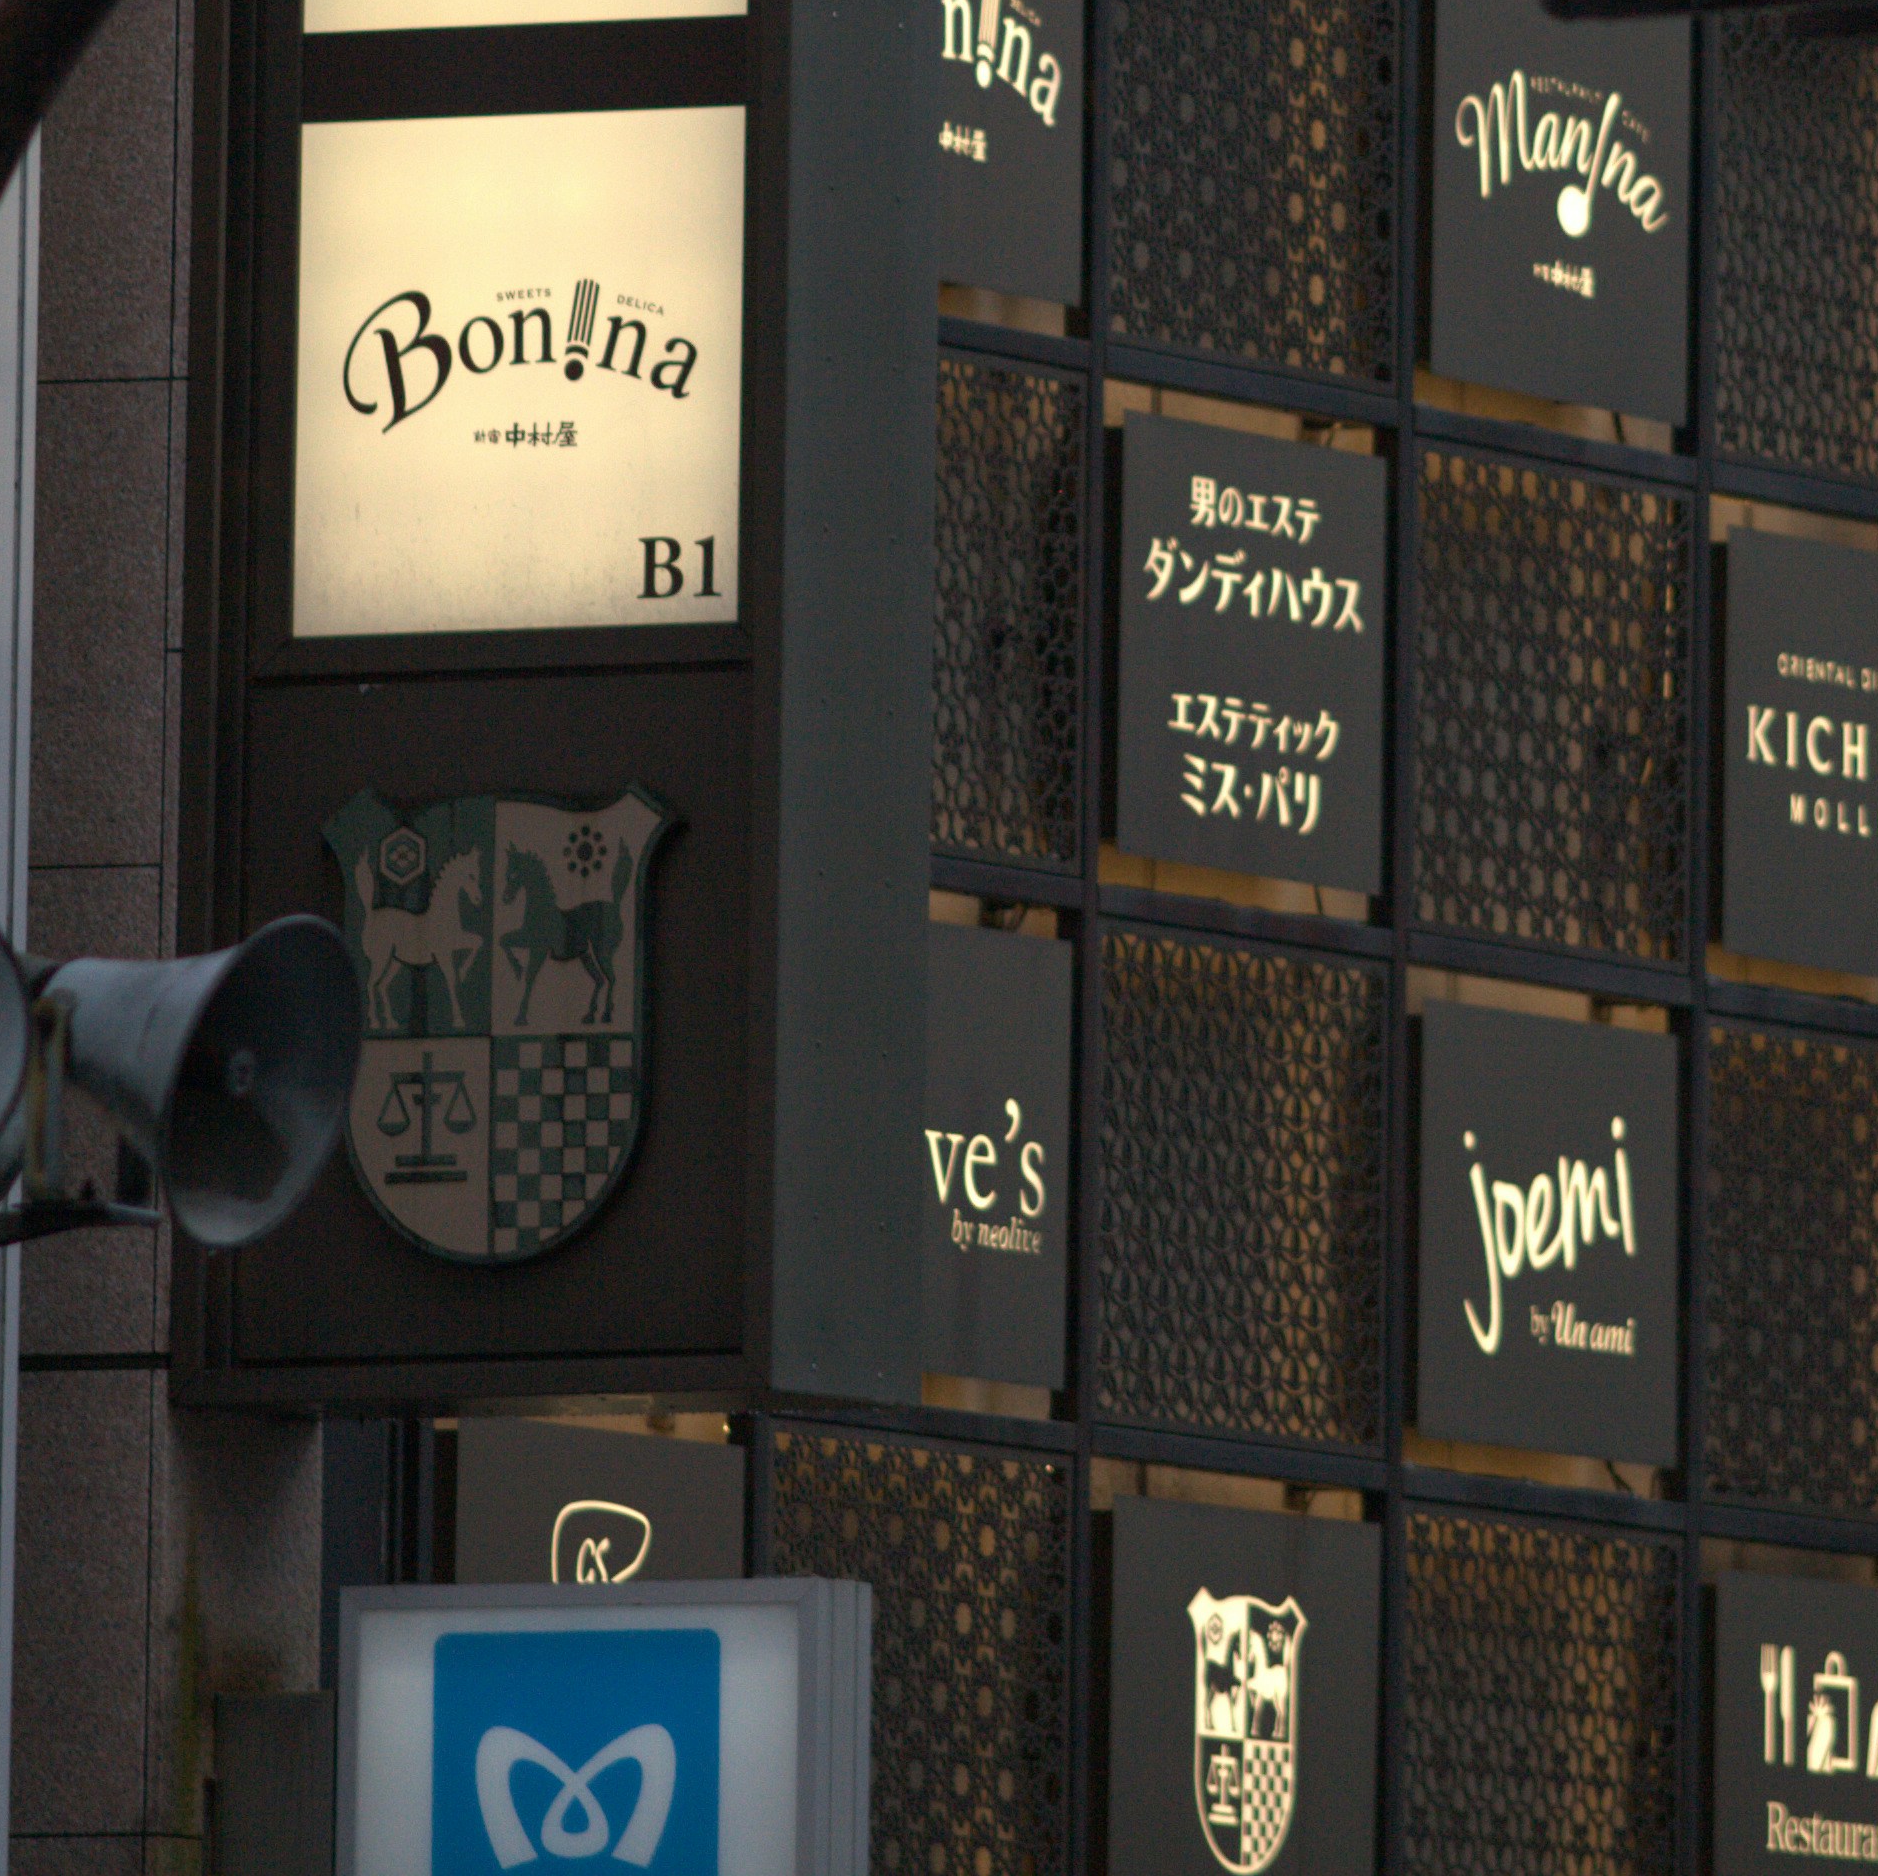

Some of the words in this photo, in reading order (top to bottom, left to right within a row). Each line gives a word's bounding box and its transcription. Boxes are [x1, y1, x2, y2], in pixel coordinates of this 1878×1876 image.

[496, 287, 552, 302] SWEETS
[616, 294, 664, 317] DELICA
[1190, 476, 1321, 545] 男のエステ
[638, 536, 722, 599] B1
[1143, 536, 1364, 633] ダンディハウス
[1777, 651, 1855, 690] ORIENTAL
[1168, 693, 1339, 761] エステティック
[1180, 753, 1320, 836] ミス・パリ
[1463, 1115, 1637, 1357] joemi
